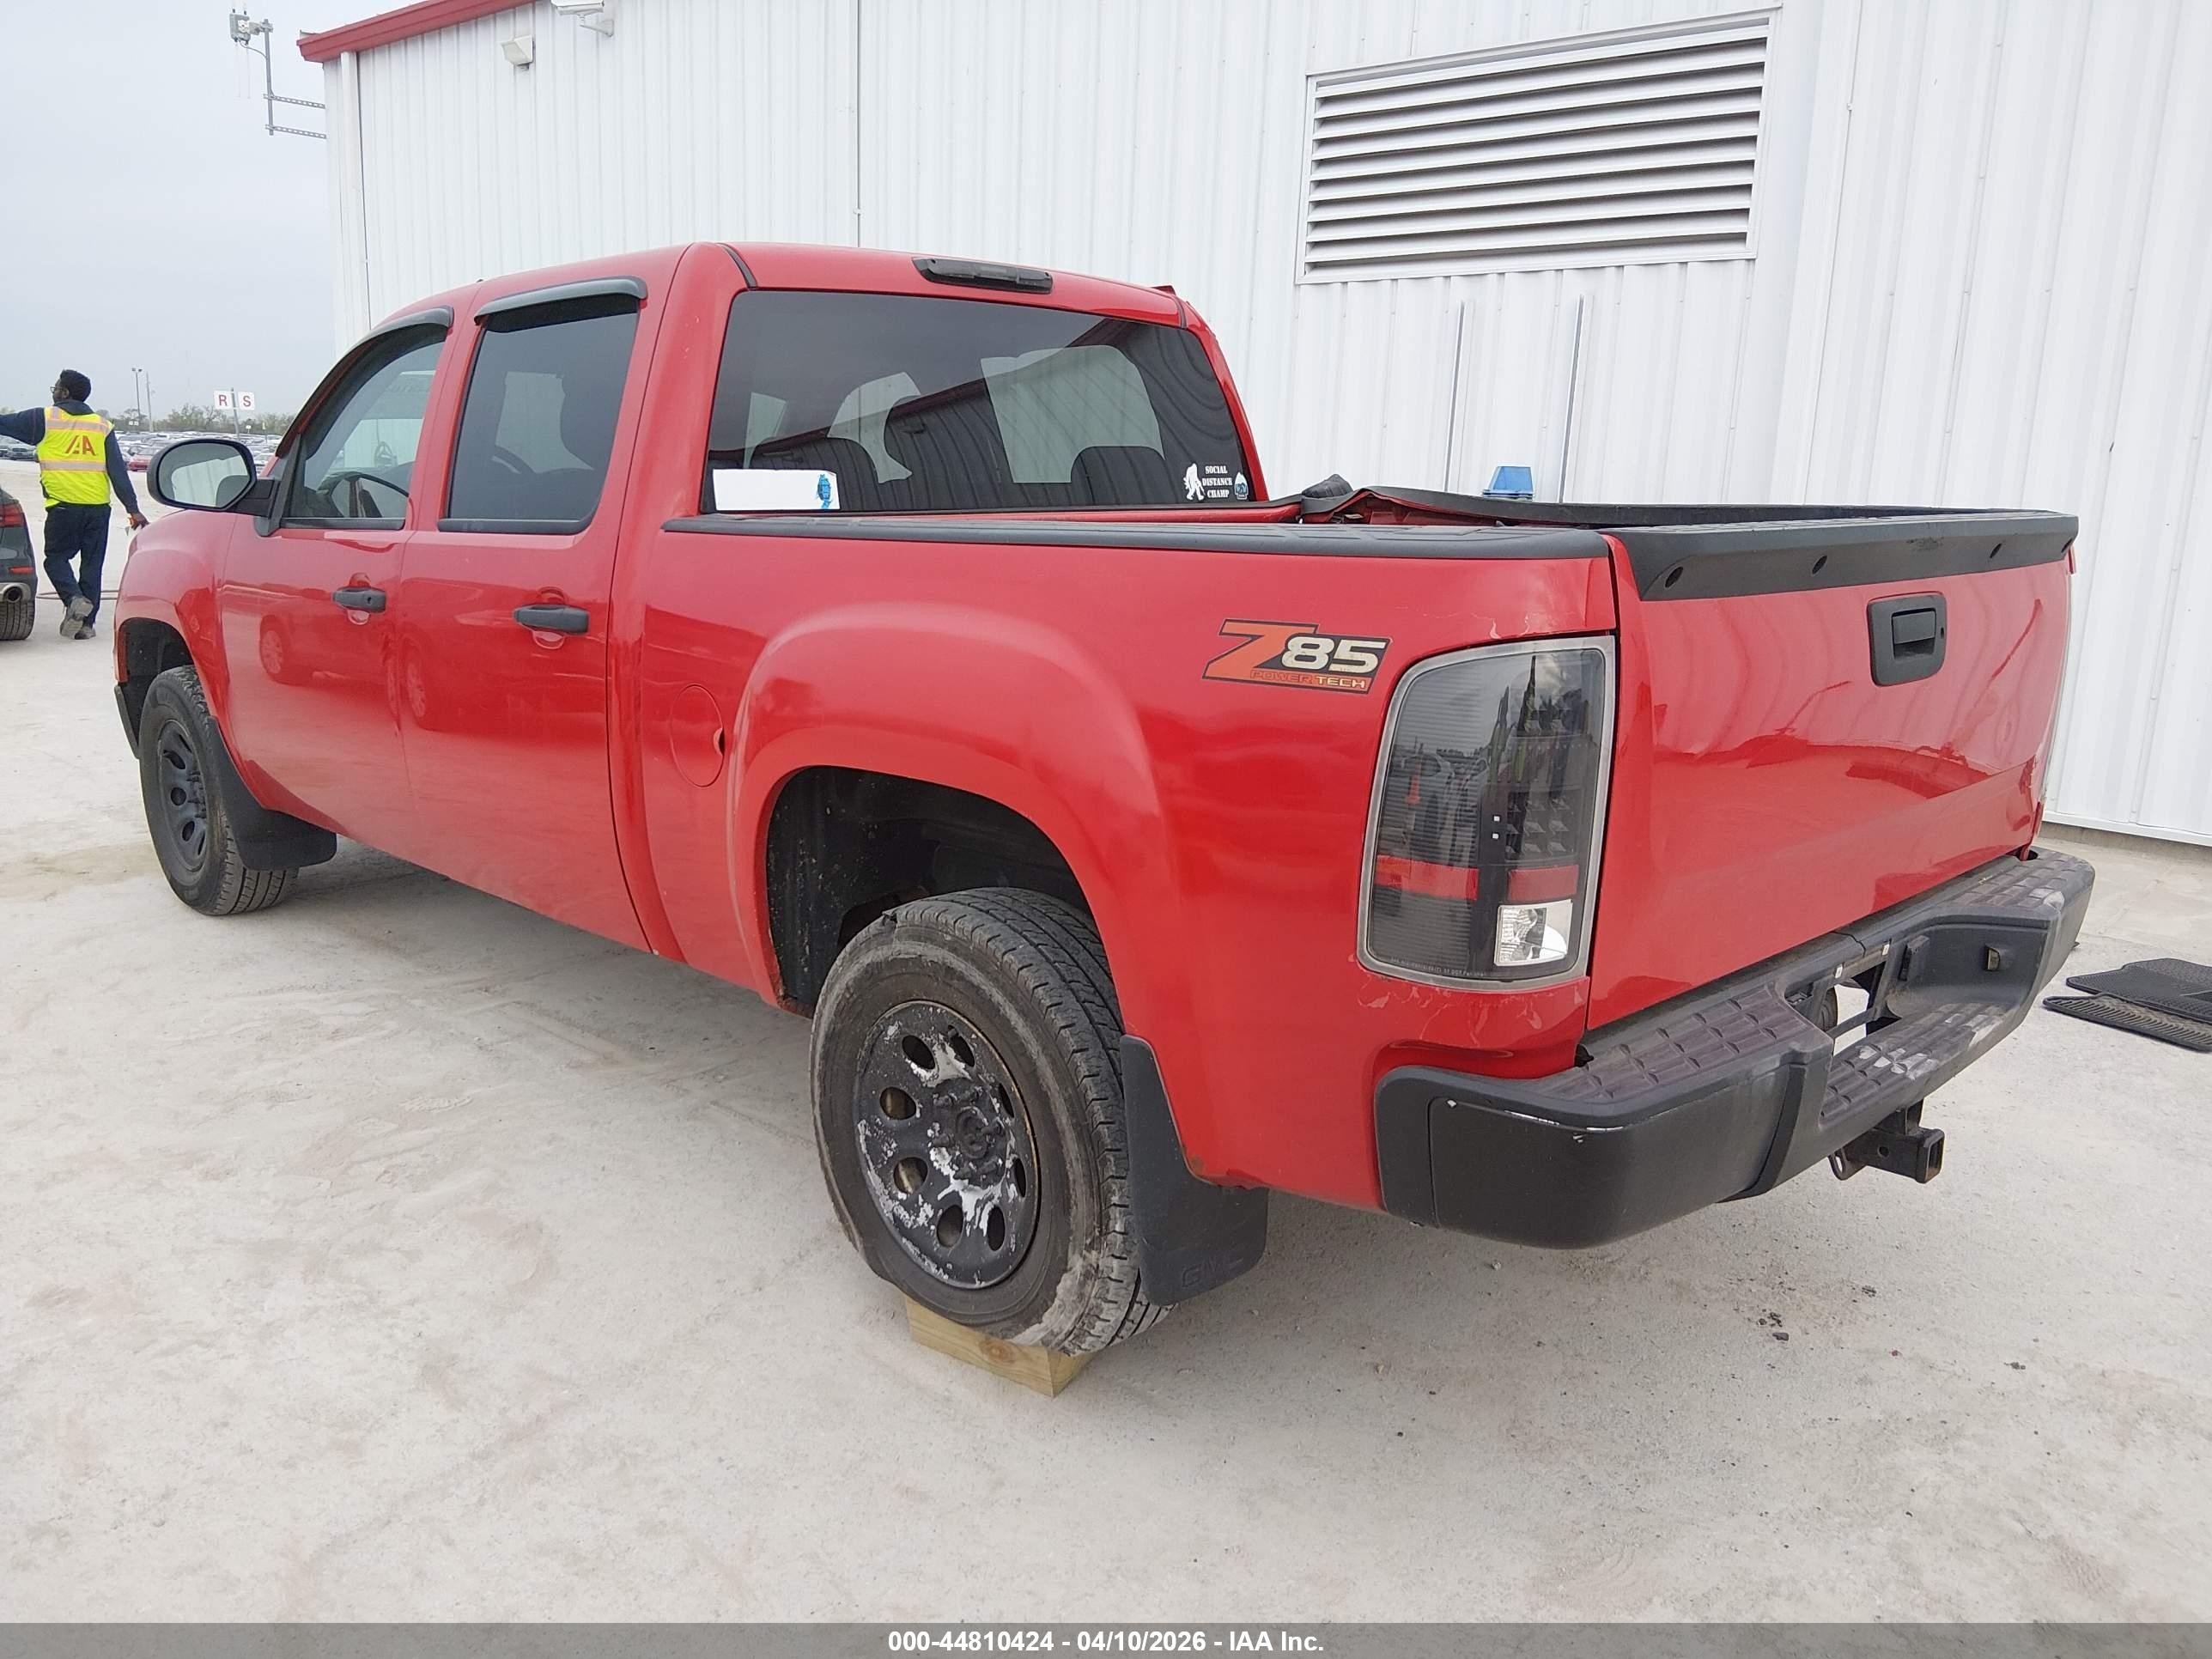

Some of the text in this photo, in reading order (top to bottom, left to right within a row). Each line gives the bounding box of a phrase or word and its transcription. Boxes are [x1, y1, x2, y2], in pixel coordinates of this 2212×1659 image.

[218, 394, 228, 406] R
[243, 395, 252, 407] S
[1205, 465, 1228, 474] SOCIAL
[1202, 477, 1233, 486] DISTANCE
[1206, 489, 1230, 498] CHAMP
[1250, 670, 1365, 689] POWER TECH
